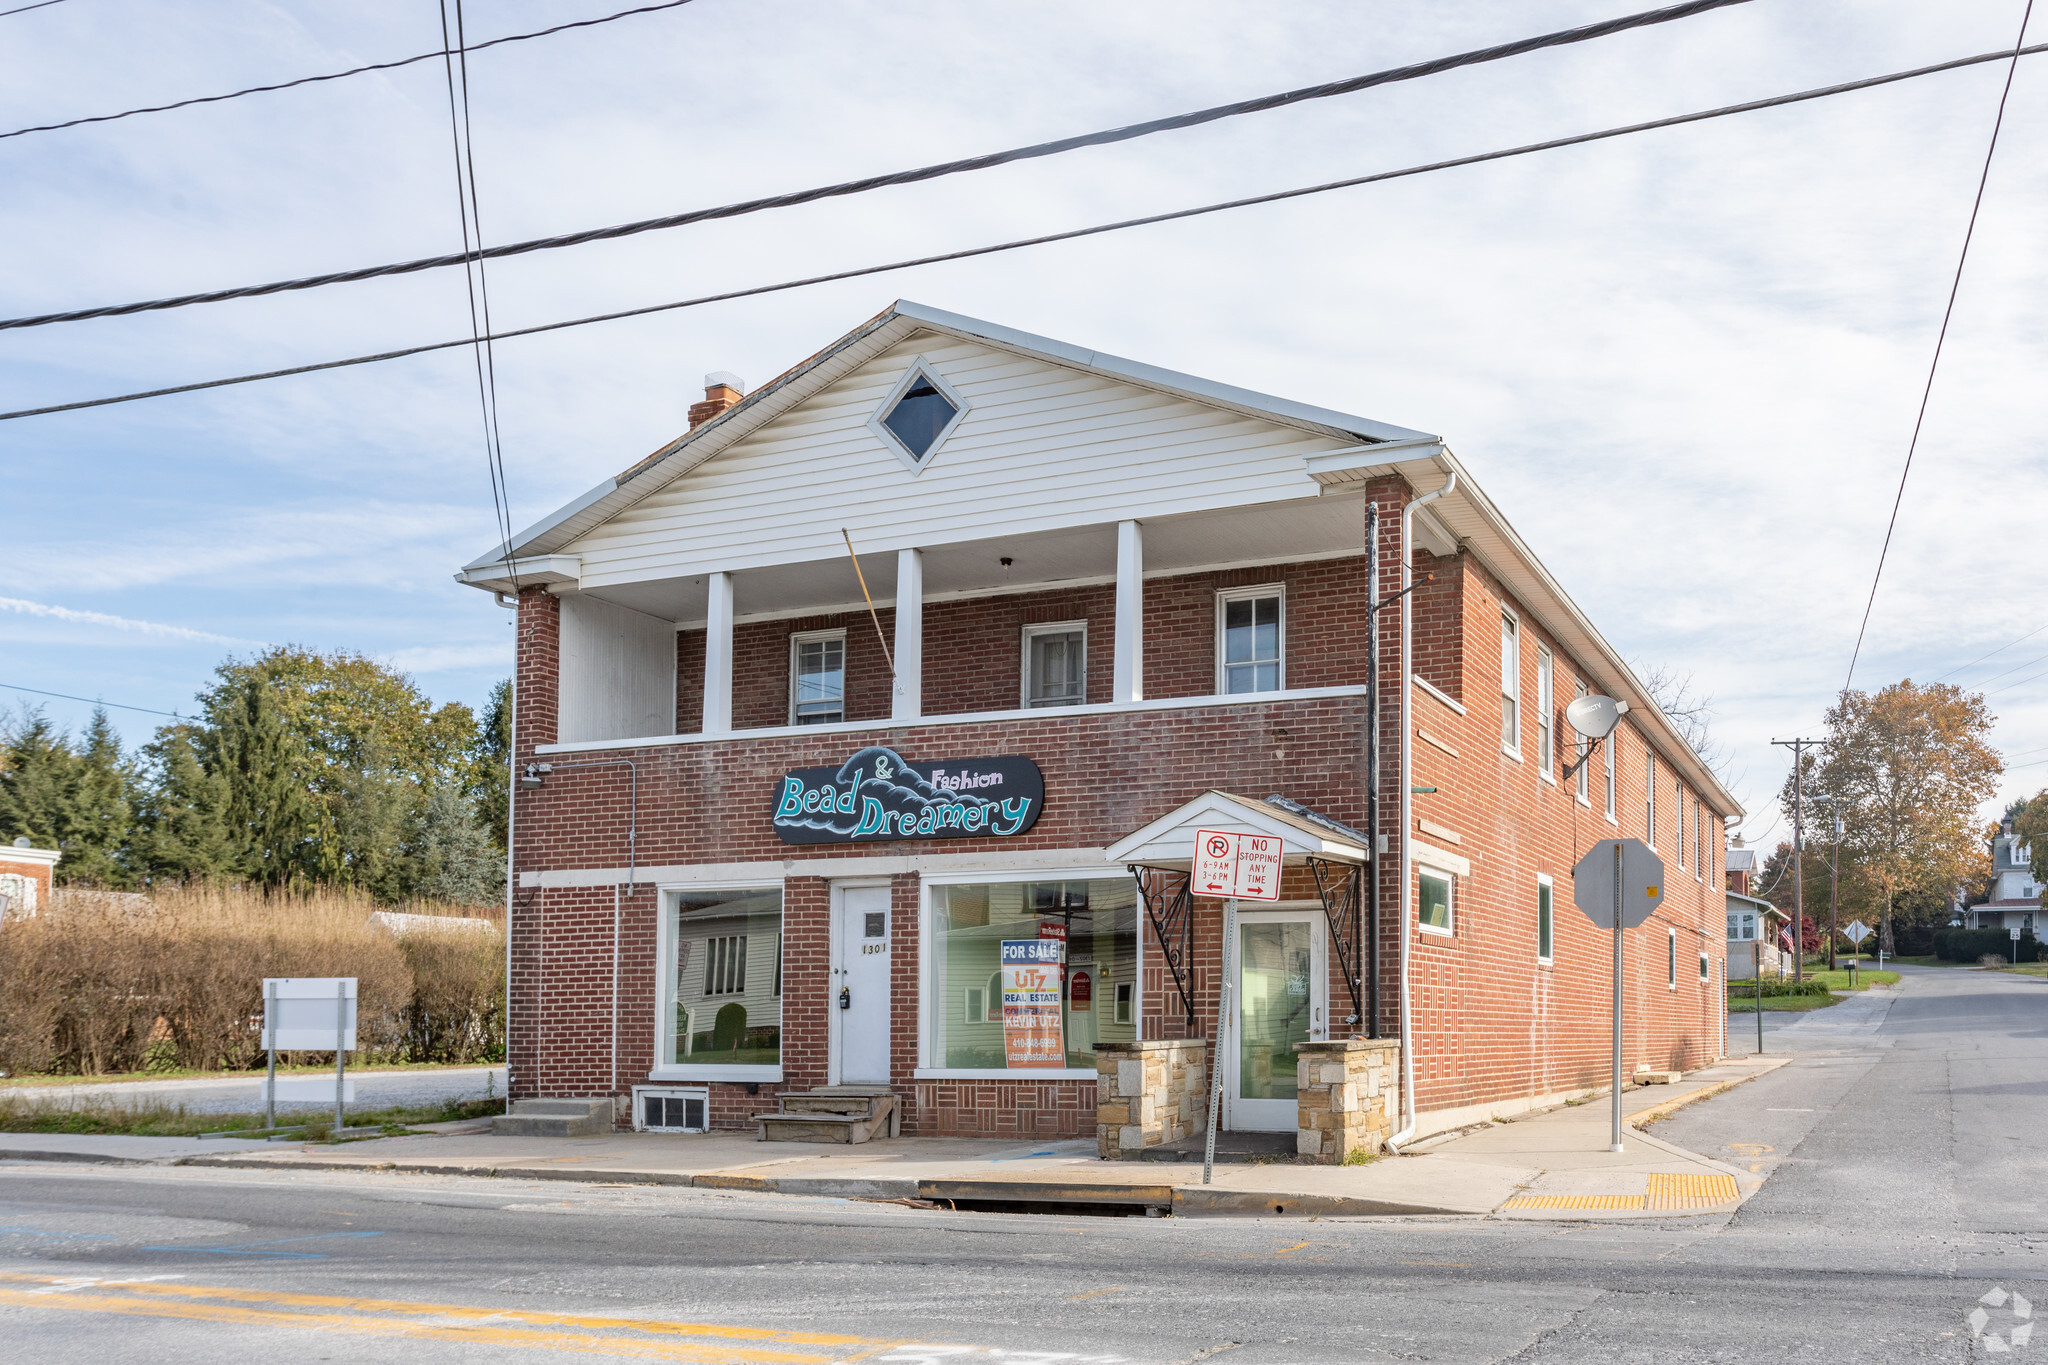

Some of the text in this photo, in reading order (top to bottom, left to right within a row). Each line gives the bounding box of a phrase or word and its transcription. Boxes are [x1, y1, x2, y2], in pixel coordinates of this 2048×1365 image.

[931, 769, 1003, 790] Fashion
[774, 755, 894, 820] Bead &
[851, 794, 1033, 838] Dreamery
[1251, 839, 1268, 851] NO
[1240, 852, 1278, 864] STOPPING
[1249, 864, 1266, 873] ANY
[1248, 874, 1266, 884] TIME
[863, 943, 886, 955] 1301
[1003, 946, 1026, 959] FOR
[1028, 945, 1057, 959] SALE
[1015, 969, 1047, 993] UTZ
[1005, 993, 1058, 1002] REAL ESTATE
[1005, 1007, 1060, 1015] COMMERCIAL
[1006, 1016, 1060, 1028] KEVIN UTZ
